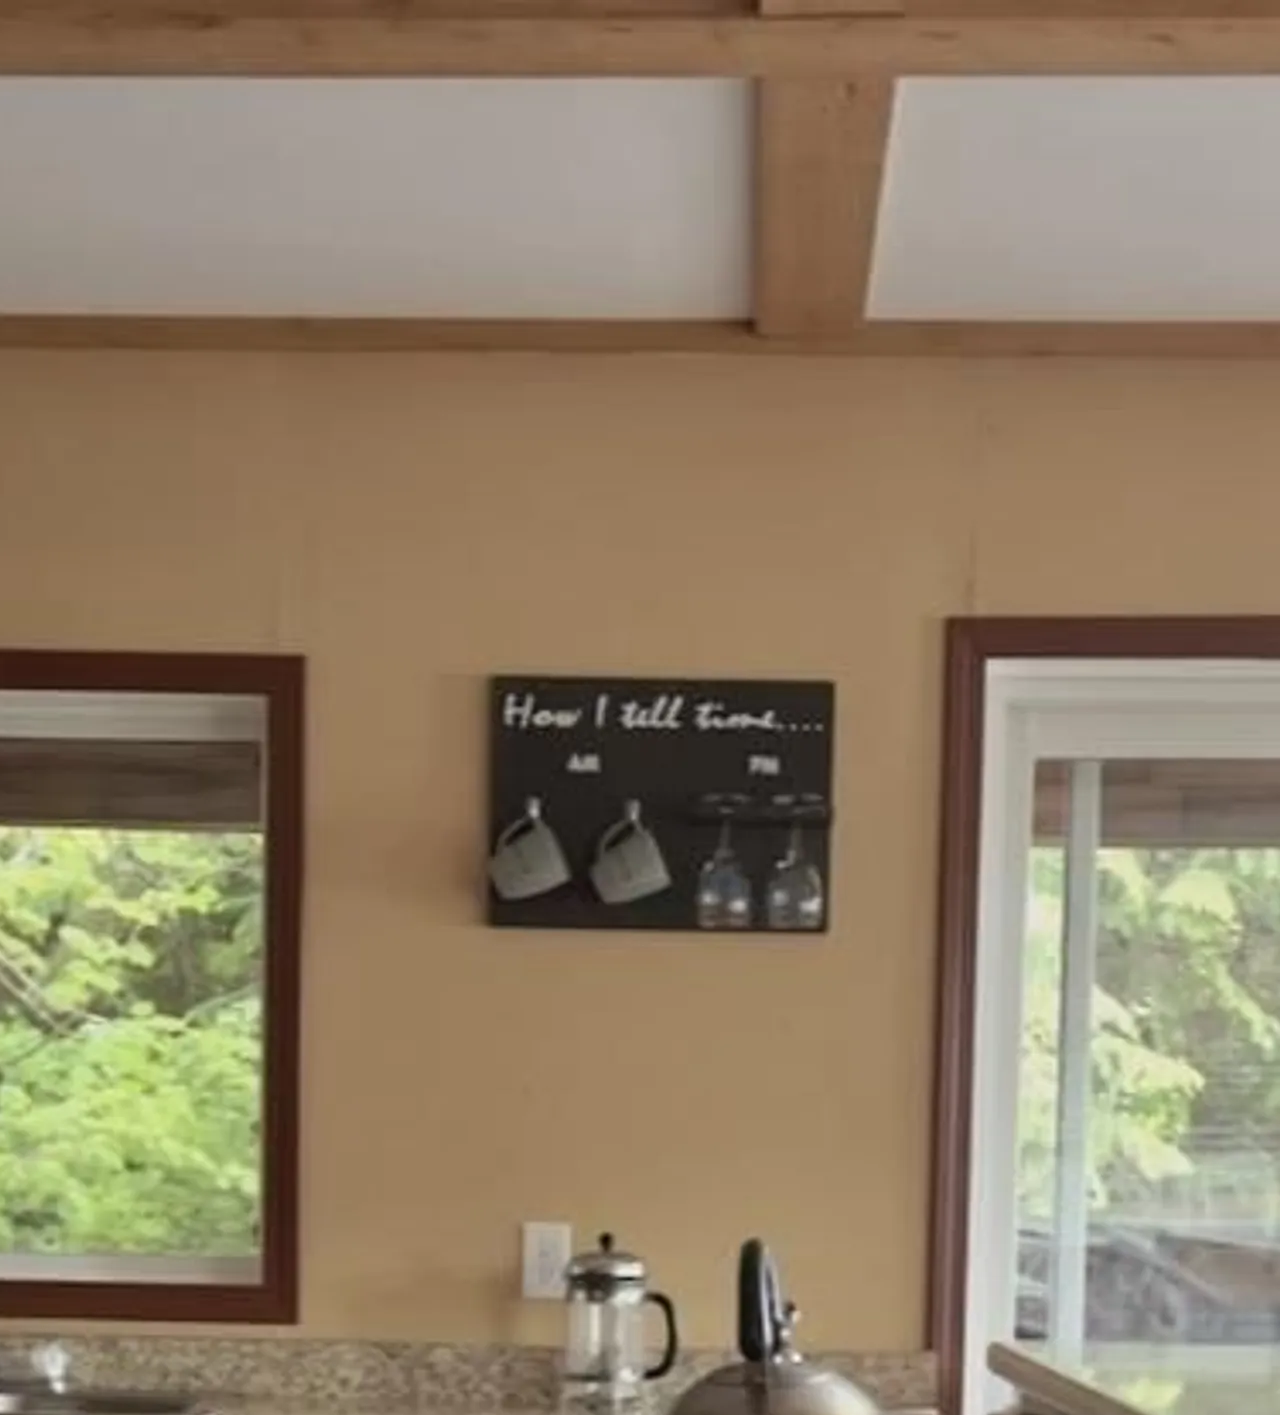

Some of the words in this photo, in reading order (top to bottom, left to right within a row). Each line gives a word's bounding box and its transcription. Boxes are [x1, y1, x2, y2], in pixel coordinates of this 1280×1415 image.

[503, 693, 582, 728] How
[594, 694, 610, 728] I
[618, 696, 684, 729] tell
